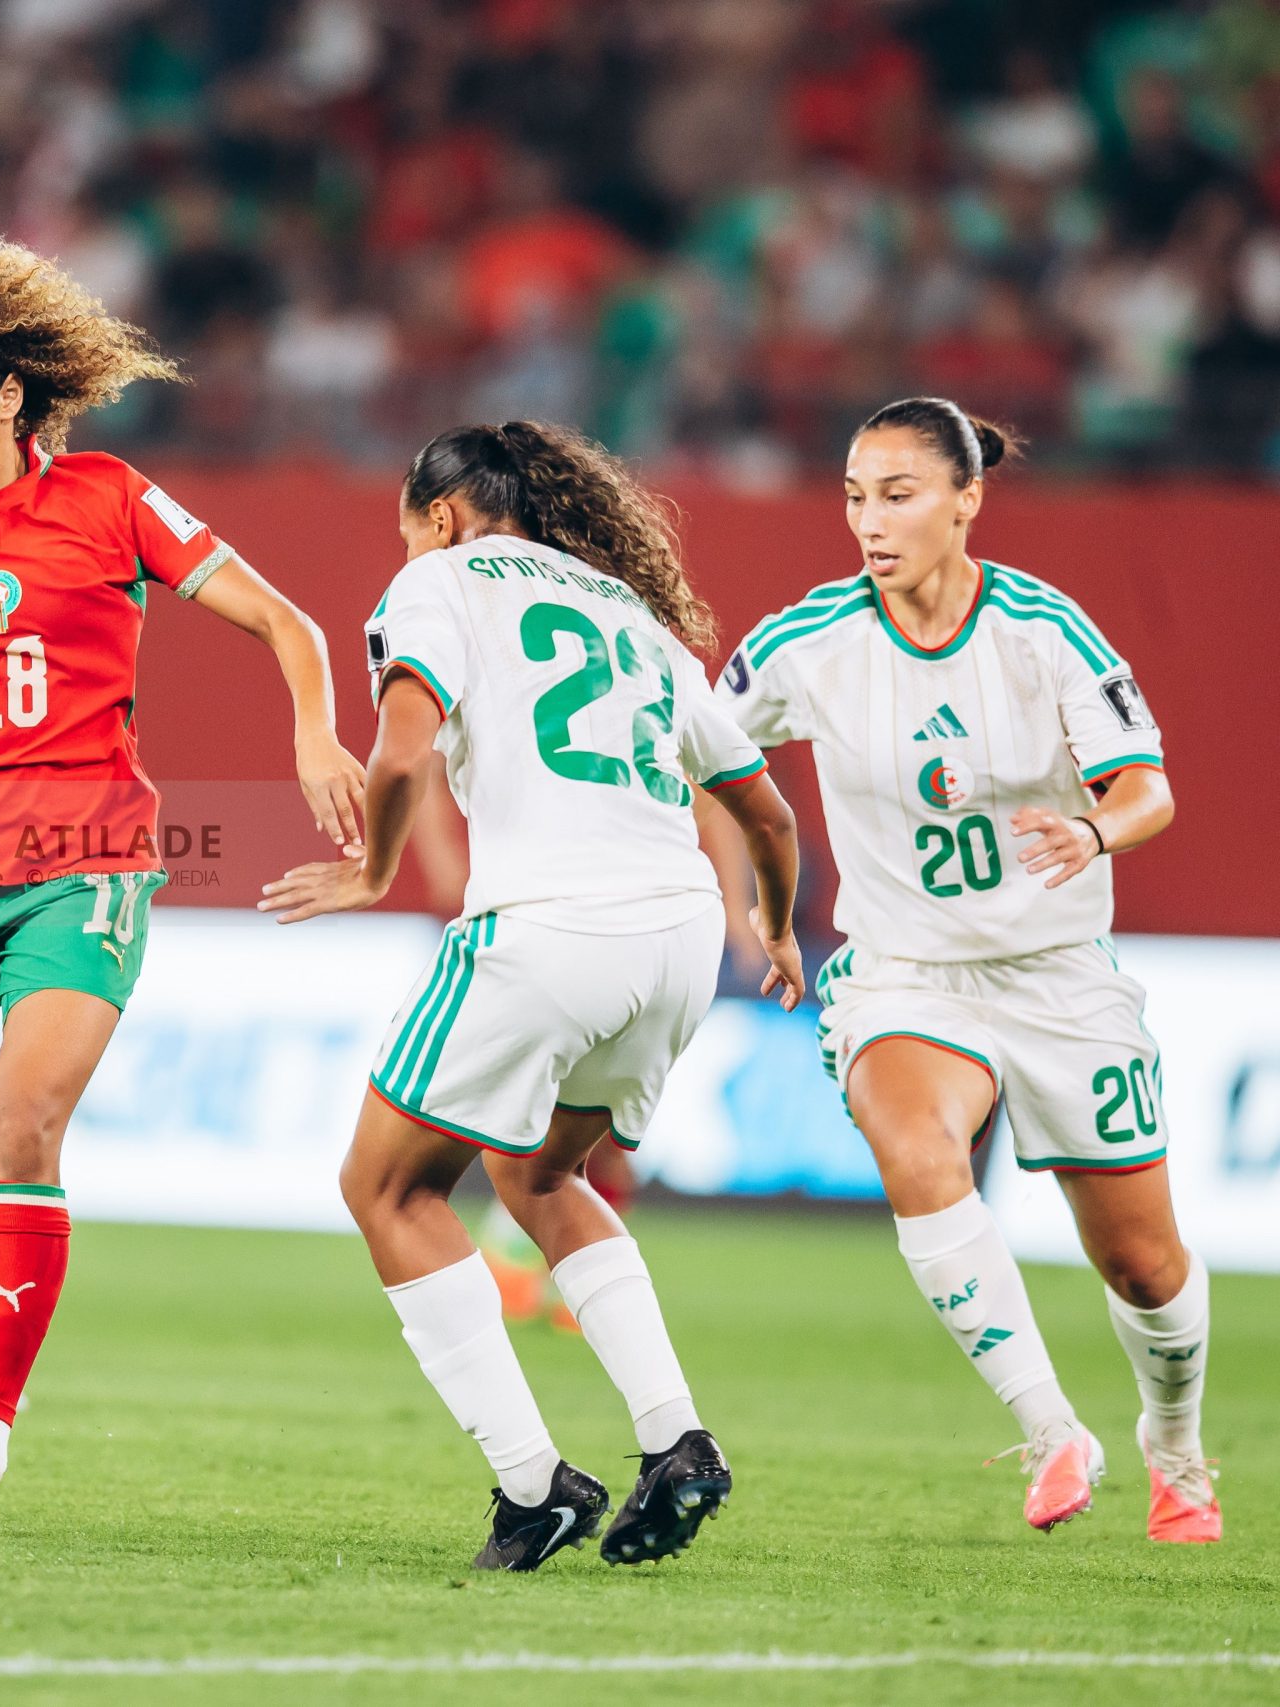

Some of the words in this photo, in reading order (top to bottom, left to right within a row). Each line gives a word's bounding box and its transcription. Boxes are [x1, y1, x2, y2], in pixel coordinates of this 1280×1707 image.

[467, 556, 567, 586] SMITS
[519, 602, 692, 807] 22
[915, 814, 1003, 898] 20
[82, 870, 150, 946] 18
[1092, 1057, 1157, 1144] 20
[932, 1278, 979, 1312] FAF
